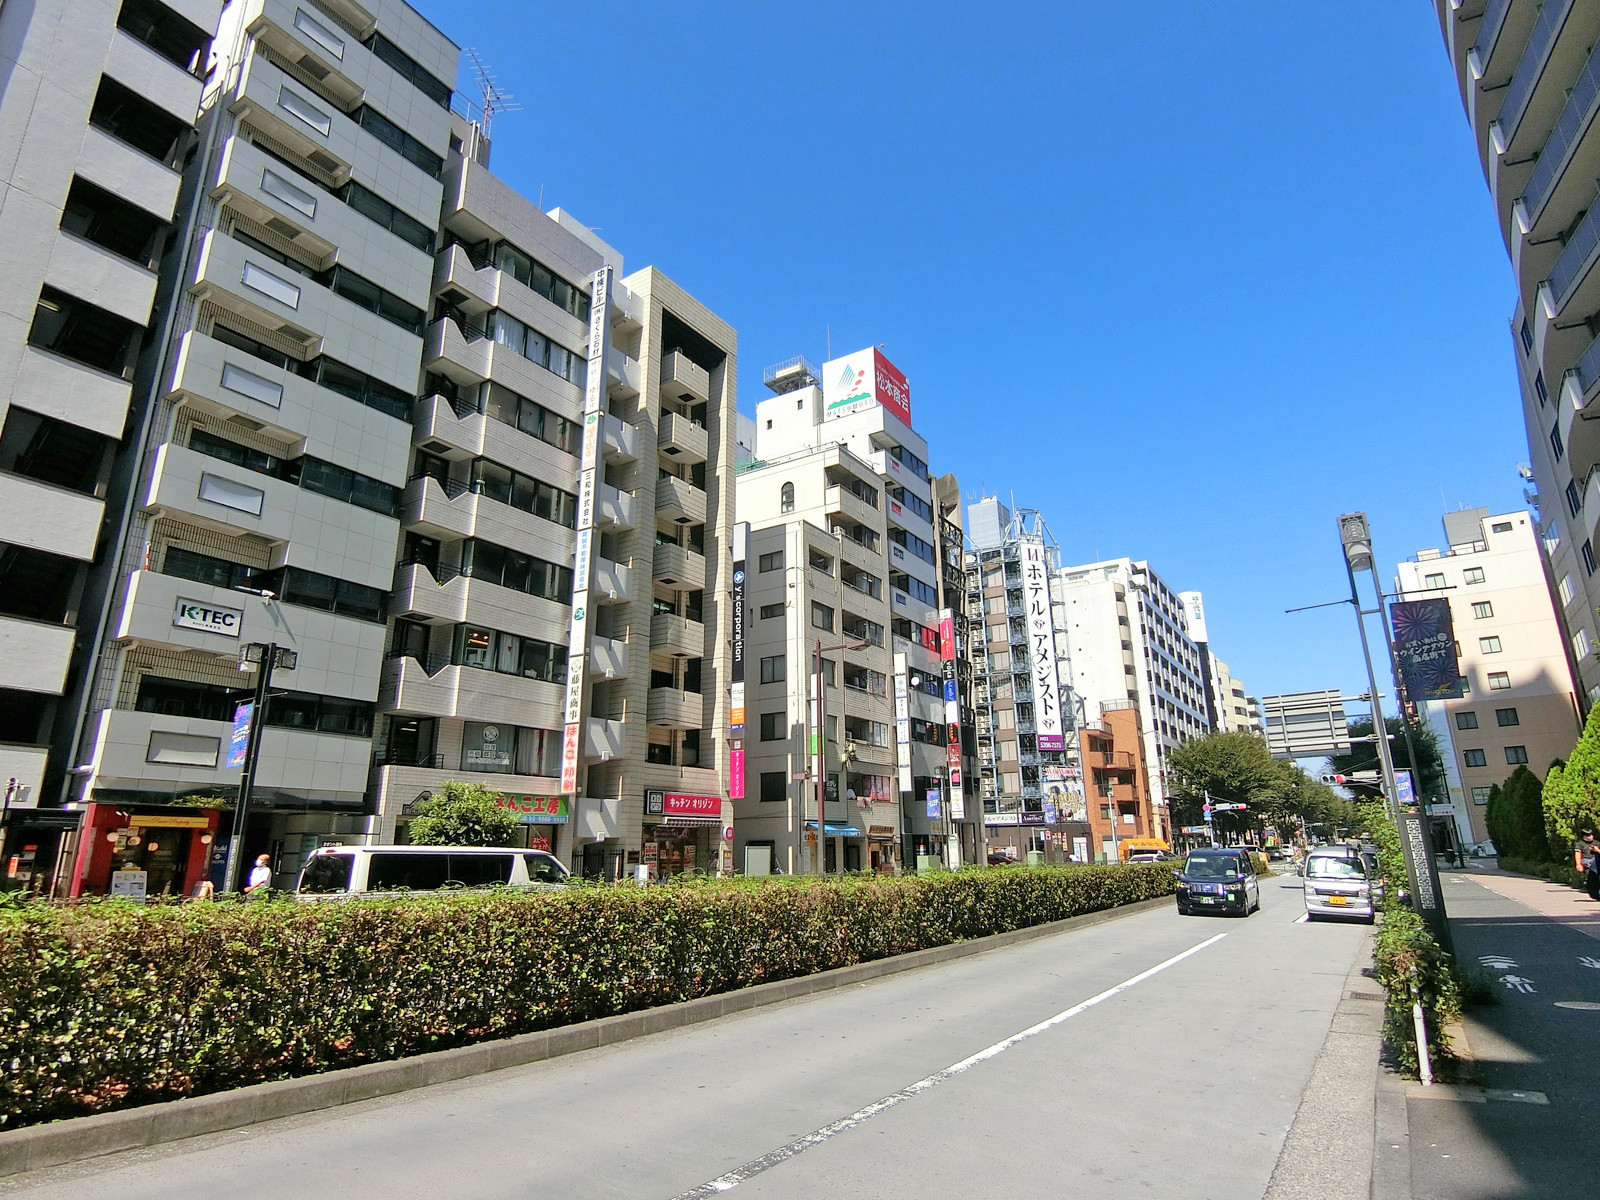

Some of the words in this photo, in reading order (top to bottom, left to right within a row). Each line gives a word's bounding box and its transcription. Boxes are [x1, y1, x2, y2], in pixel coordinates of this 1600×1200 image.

[827, 398, 874, 418] MATSUMOTO
[1028, 564, 1046, 616] ホテル
[735, 601, 743, 662] corporation
[1033, 633, 1054, 716] アメジスト
[670, 797, 691, 808] キッチン
[693, 798, 713, 809] オリジン
